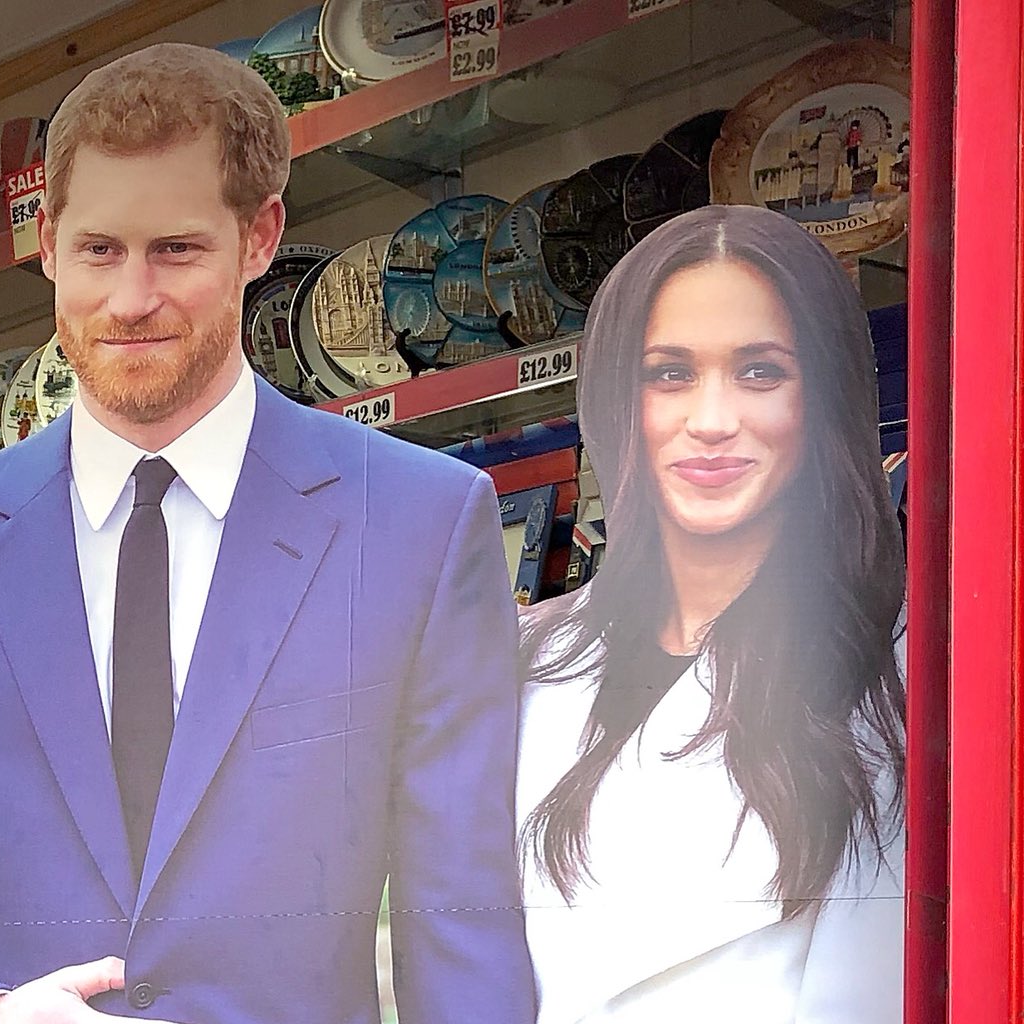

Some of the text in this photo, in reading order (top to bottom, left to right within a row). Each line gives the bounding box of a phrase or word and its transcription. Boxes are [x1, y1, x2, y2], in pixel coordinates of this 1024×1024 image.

[450, 6, 495, 37] £7.99
[453, 47, 495, 76] £2.99
[8, 166, 45, 196] SALE
[806, 216, 869, 234] LONDON
[520, 350, 573, 384] £12.99
